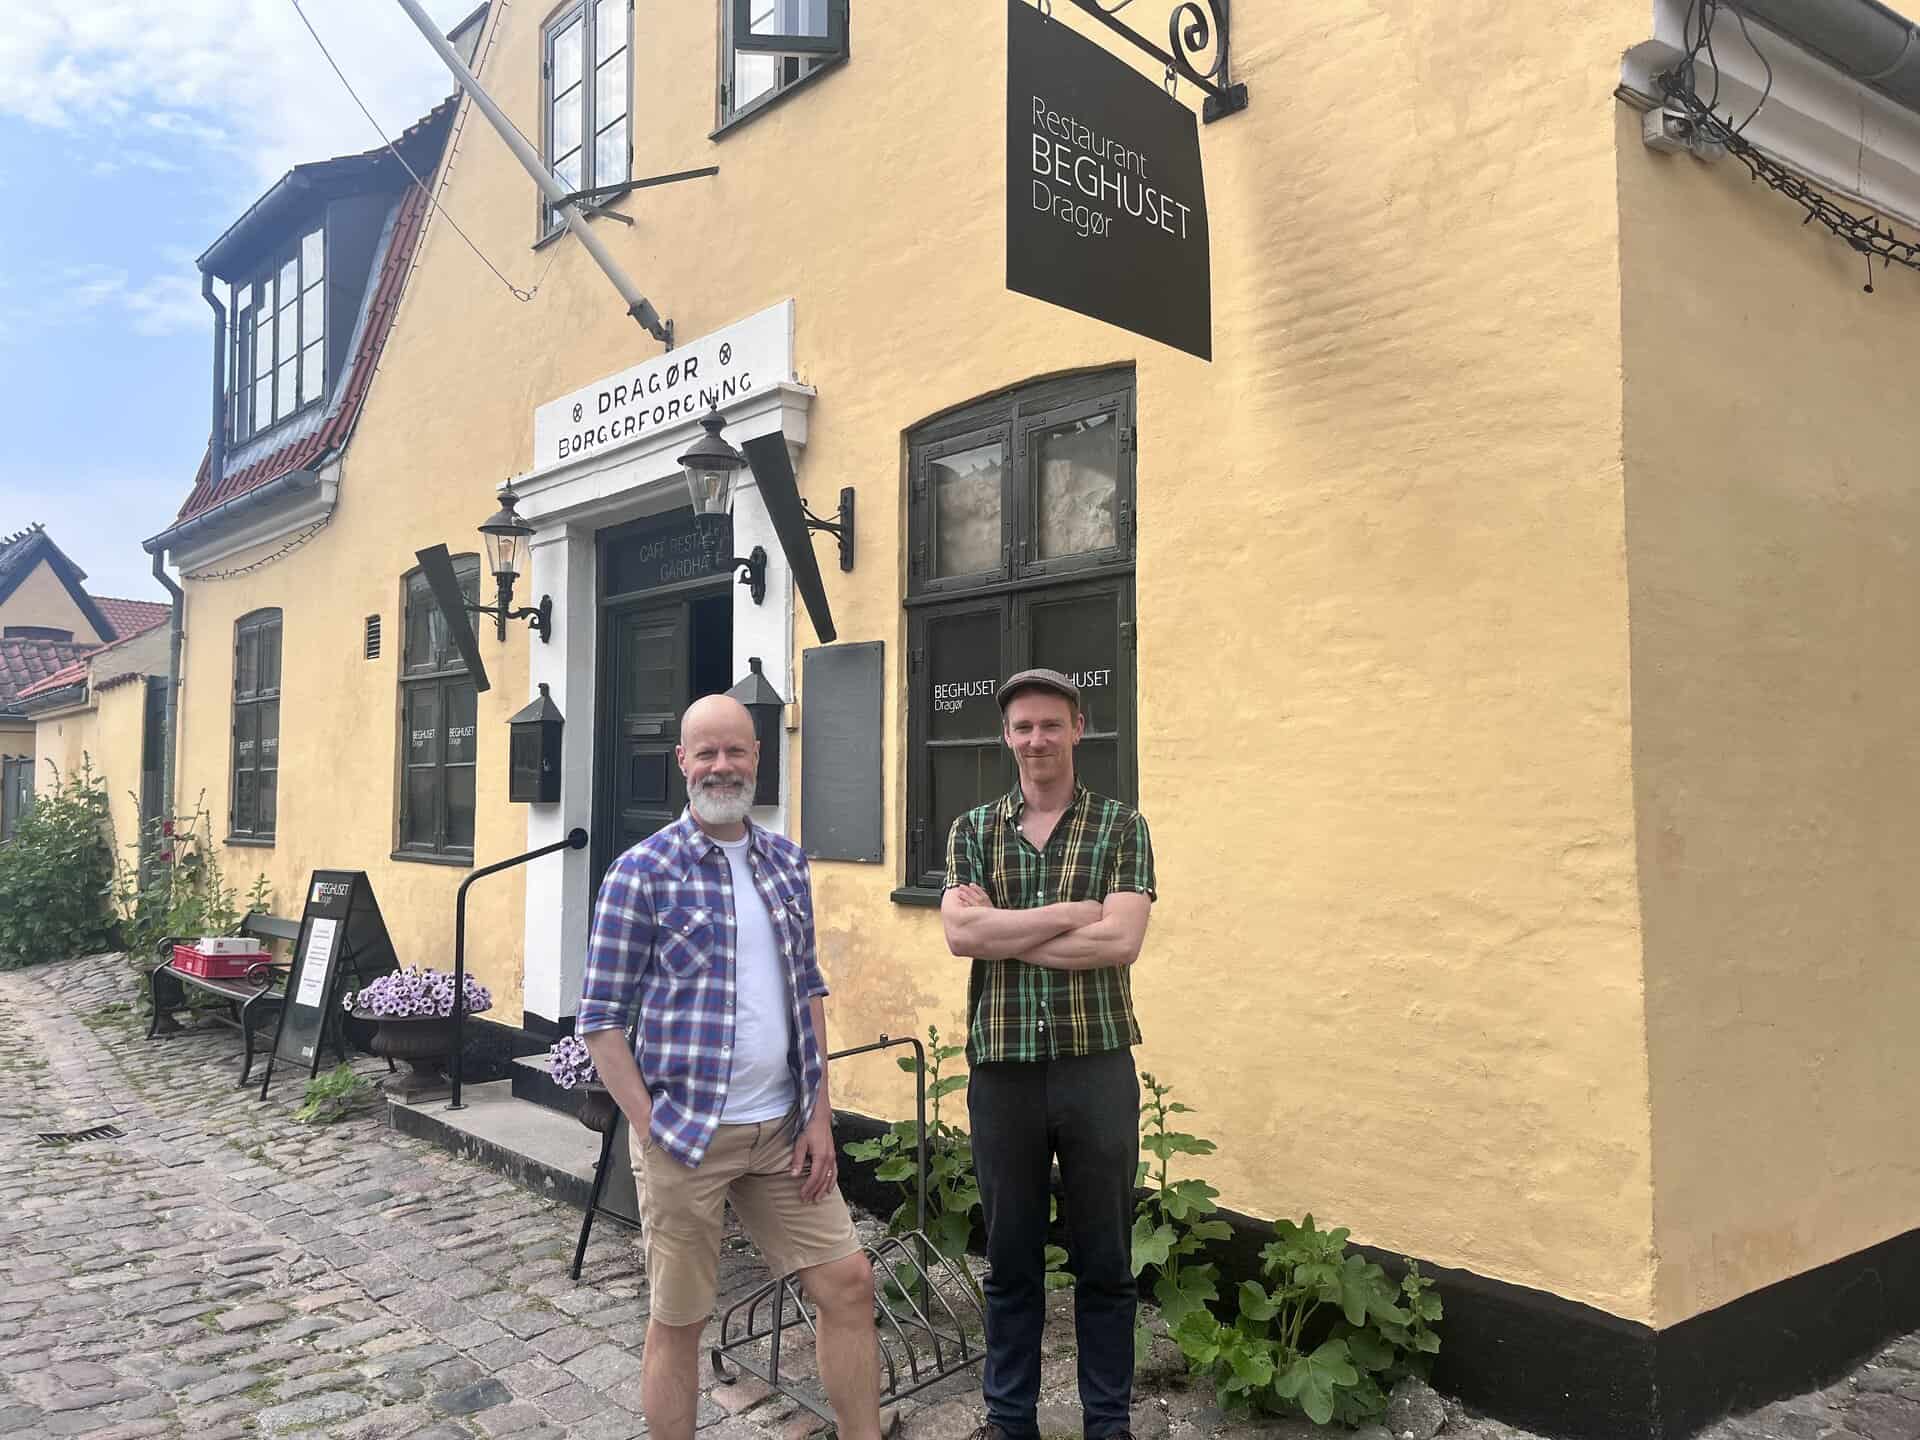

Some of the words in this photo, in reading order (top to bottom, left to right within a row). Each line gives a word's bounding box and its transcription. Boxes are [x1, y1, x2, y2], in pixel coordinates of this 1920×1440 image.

[1032, 95, 1149, 179] Restaurant
[1032, 132, 1192, 240] BEGHUSET
[1032, 179, 1113, 238] Dragør
[598, 356, 699, 415] DRAGØR
[558, 372, 752, 459] BORGERFORENING
[934, 679, 996, 699] BEGHUSET
[934, 699, 964, 714] Dragør
[1064, 669, 1112, 688] HUSET
